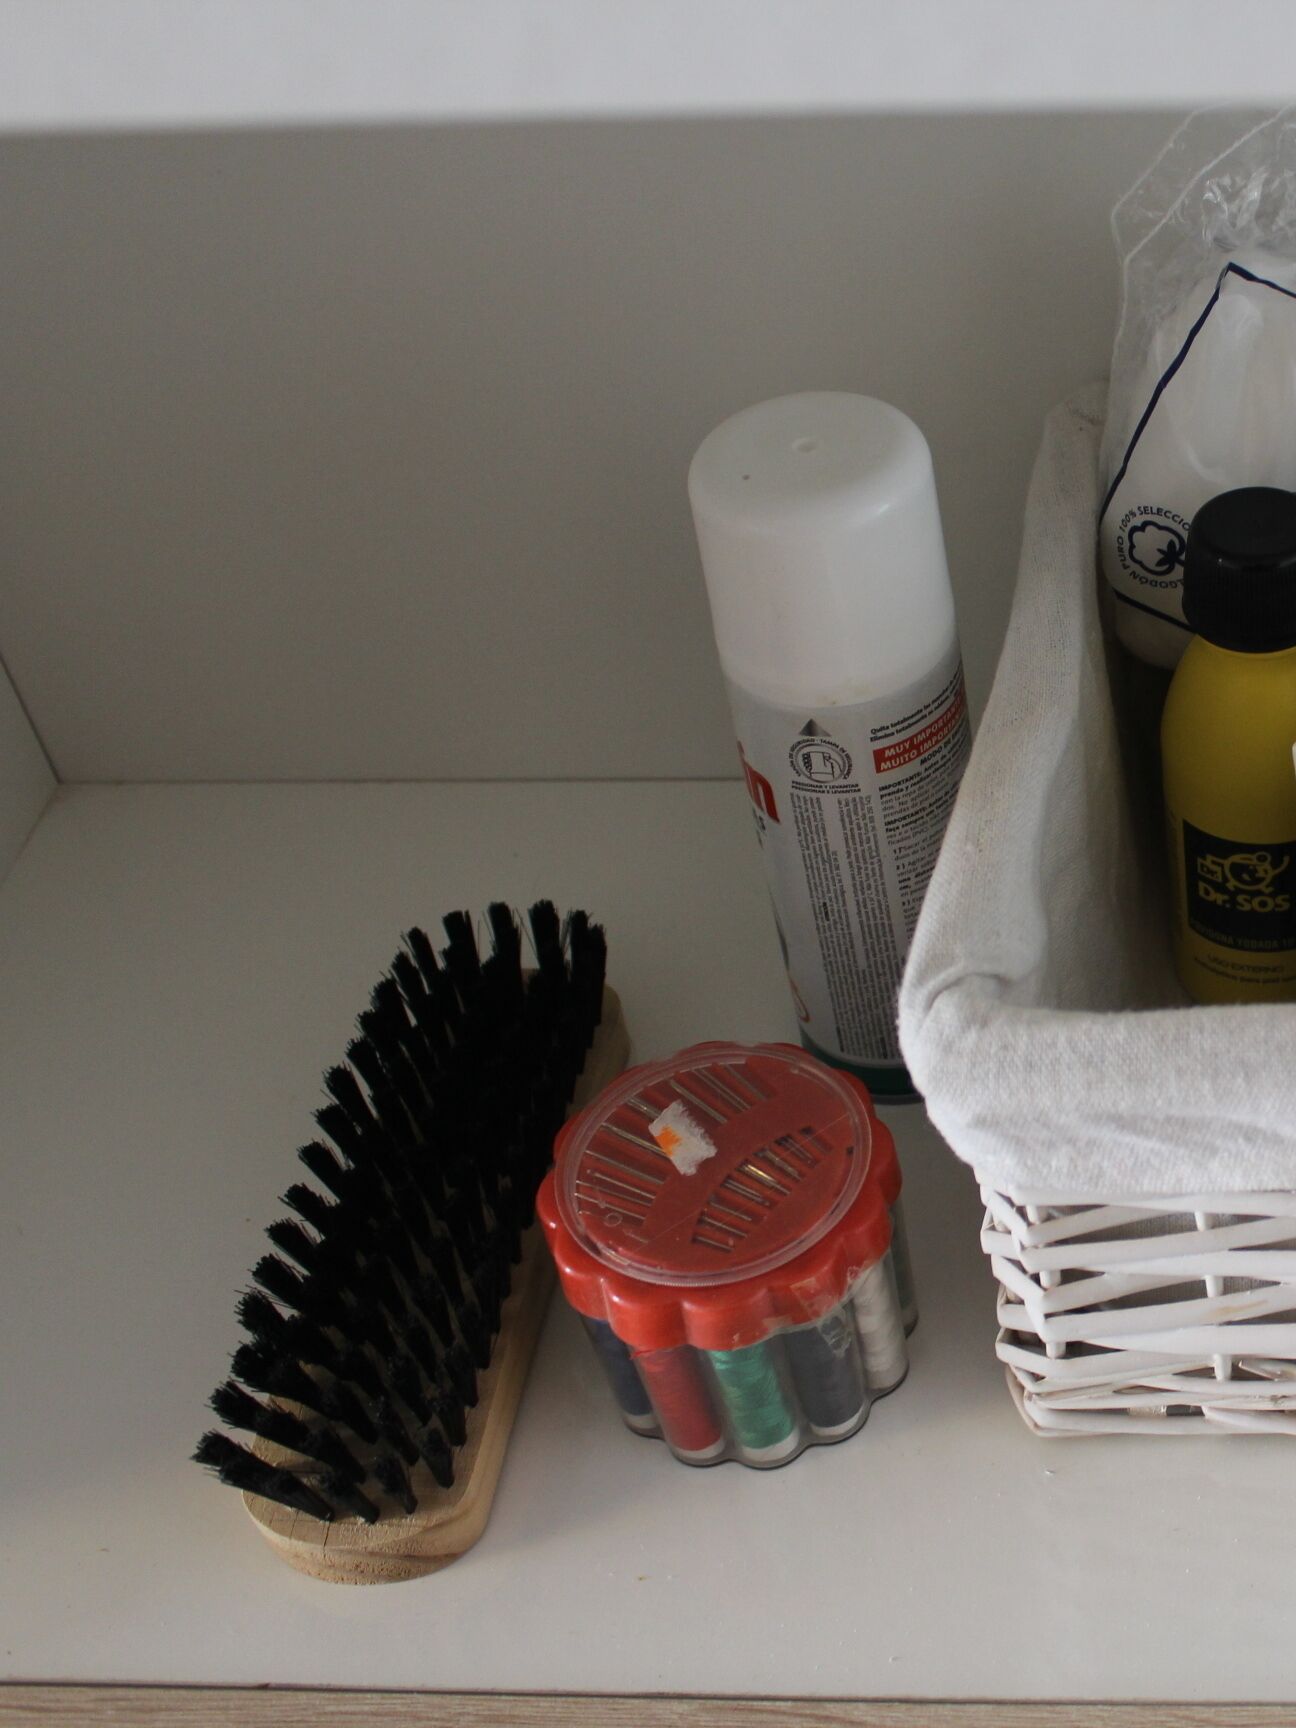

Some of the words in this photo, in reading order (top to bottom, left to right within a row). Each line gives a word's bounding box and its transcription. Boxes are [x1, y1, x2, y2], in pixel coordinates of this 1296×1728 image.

[1118, 507, 1137, 533] 100%
[1137, 505, 1192, 532] SELECCIO
[1116, 535, 1131, 571] PURO
[1129, 570, 1184, 589] LGODÓN
[880, 749, 918, 771] MUITO
[884, 741, 911, 758] MUY
[1236, 894, 1291, 913] SOS
